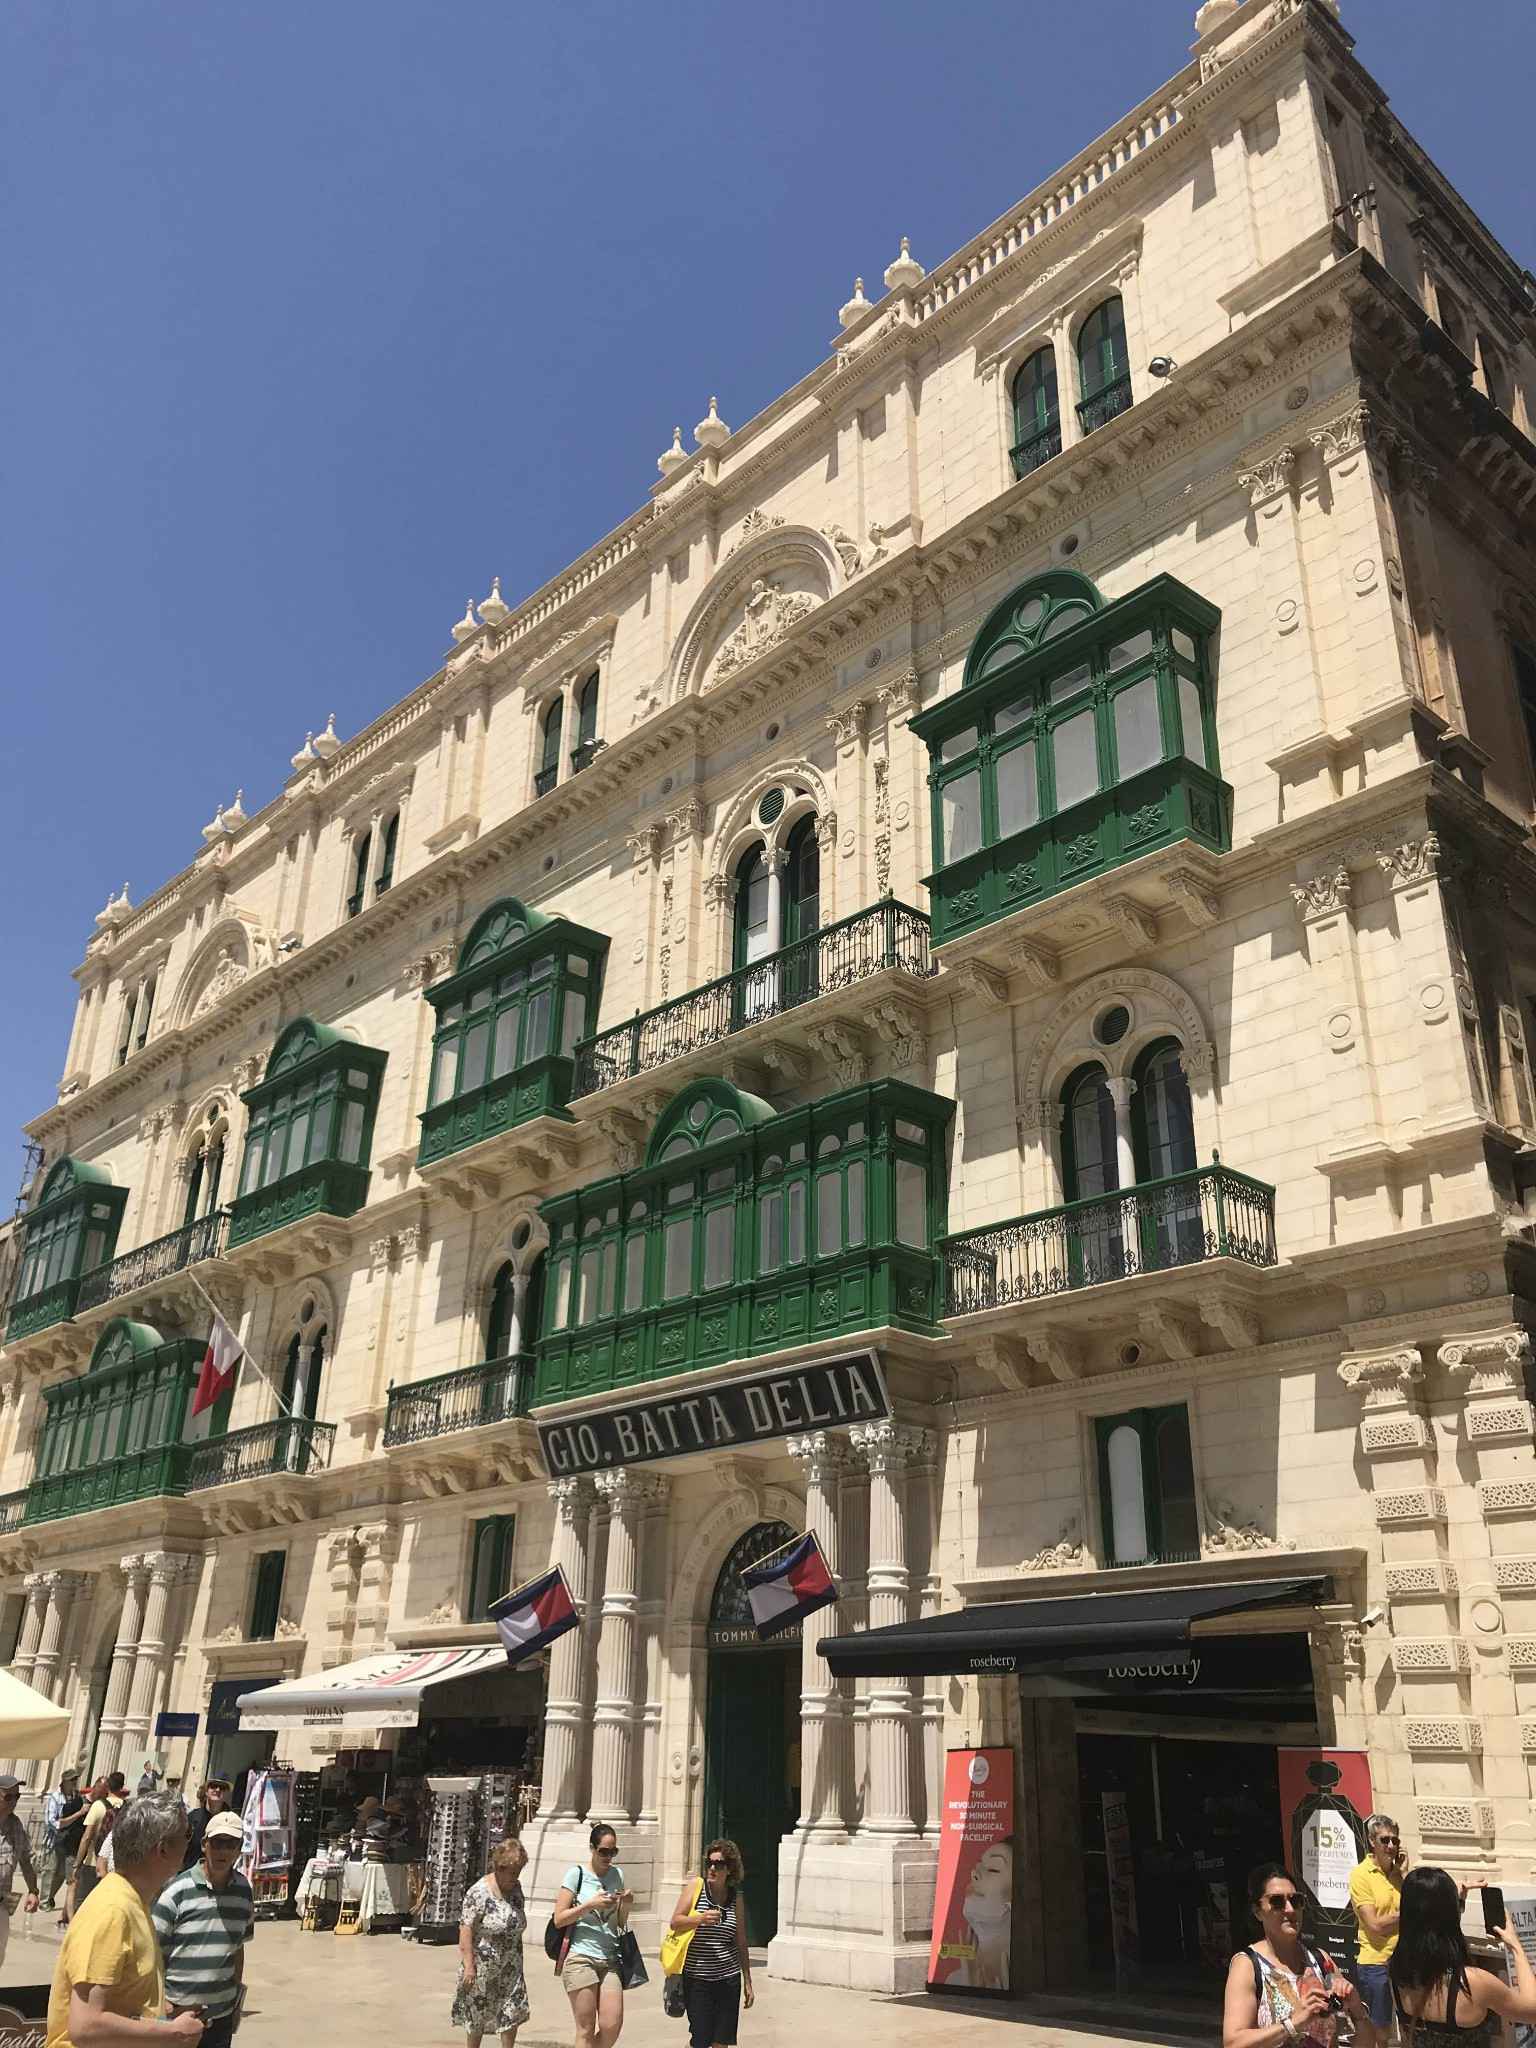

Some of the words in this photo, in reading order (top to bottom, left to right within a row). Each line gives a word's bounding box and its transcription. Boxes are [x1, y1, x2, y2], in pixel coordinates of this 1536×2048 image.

[547, 1423, 612, 1471] GIO.
[614, 1395, 736, 1458] BATTA
[743, 1364, 877, 1433] DELIA
[714, 1629, 756, 1643] TOMMY
[969, 1654, 1017, 1671] roseberry
[948, 1800, 1008, 1809] REVOLUTIONARY
[969, 1812, 997, 1820] MINUTE
[1511, 1910, 1532, 1928] ALTA
